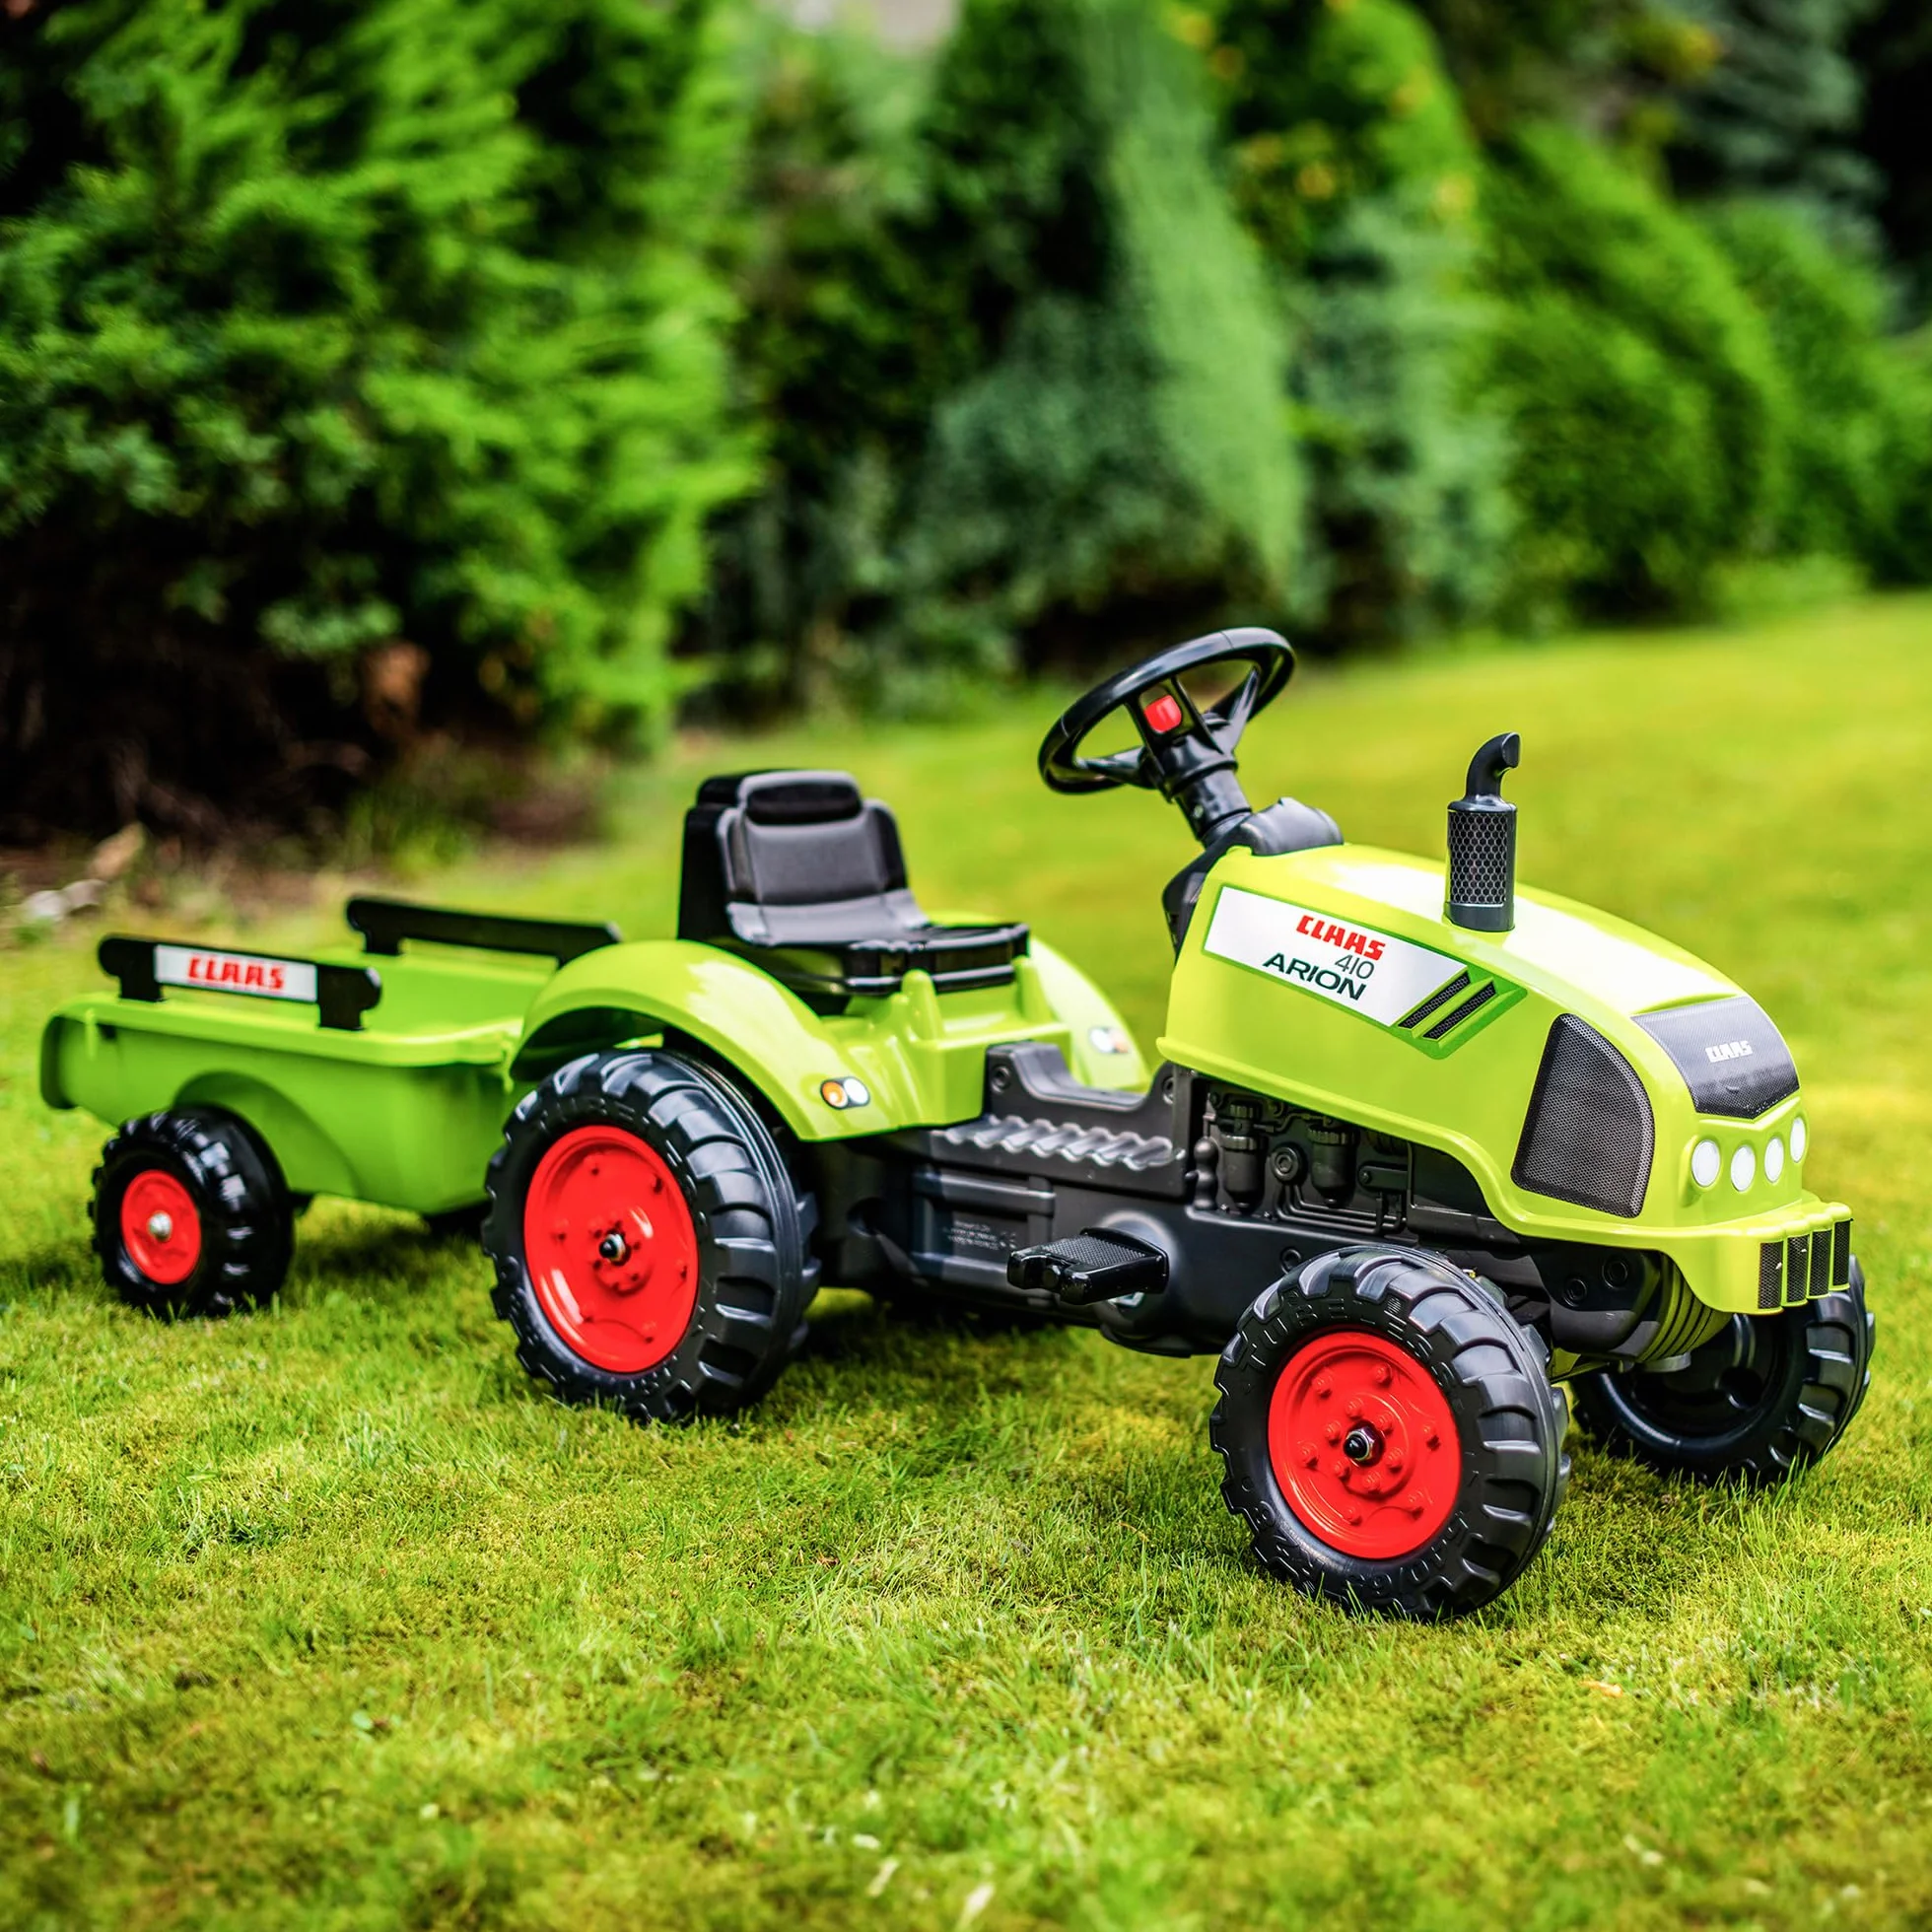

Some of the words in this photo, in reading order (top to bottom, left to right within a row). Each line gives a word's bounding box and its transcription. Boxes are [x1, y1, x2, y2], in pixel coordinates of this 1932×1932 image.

[1296, 915, 1386, 960] CLAAS
[188, 955, 284, 989] CLAAS
[1263, 952, 1366, 1000] ARION
[1335, 954, 1375, 979] 410
